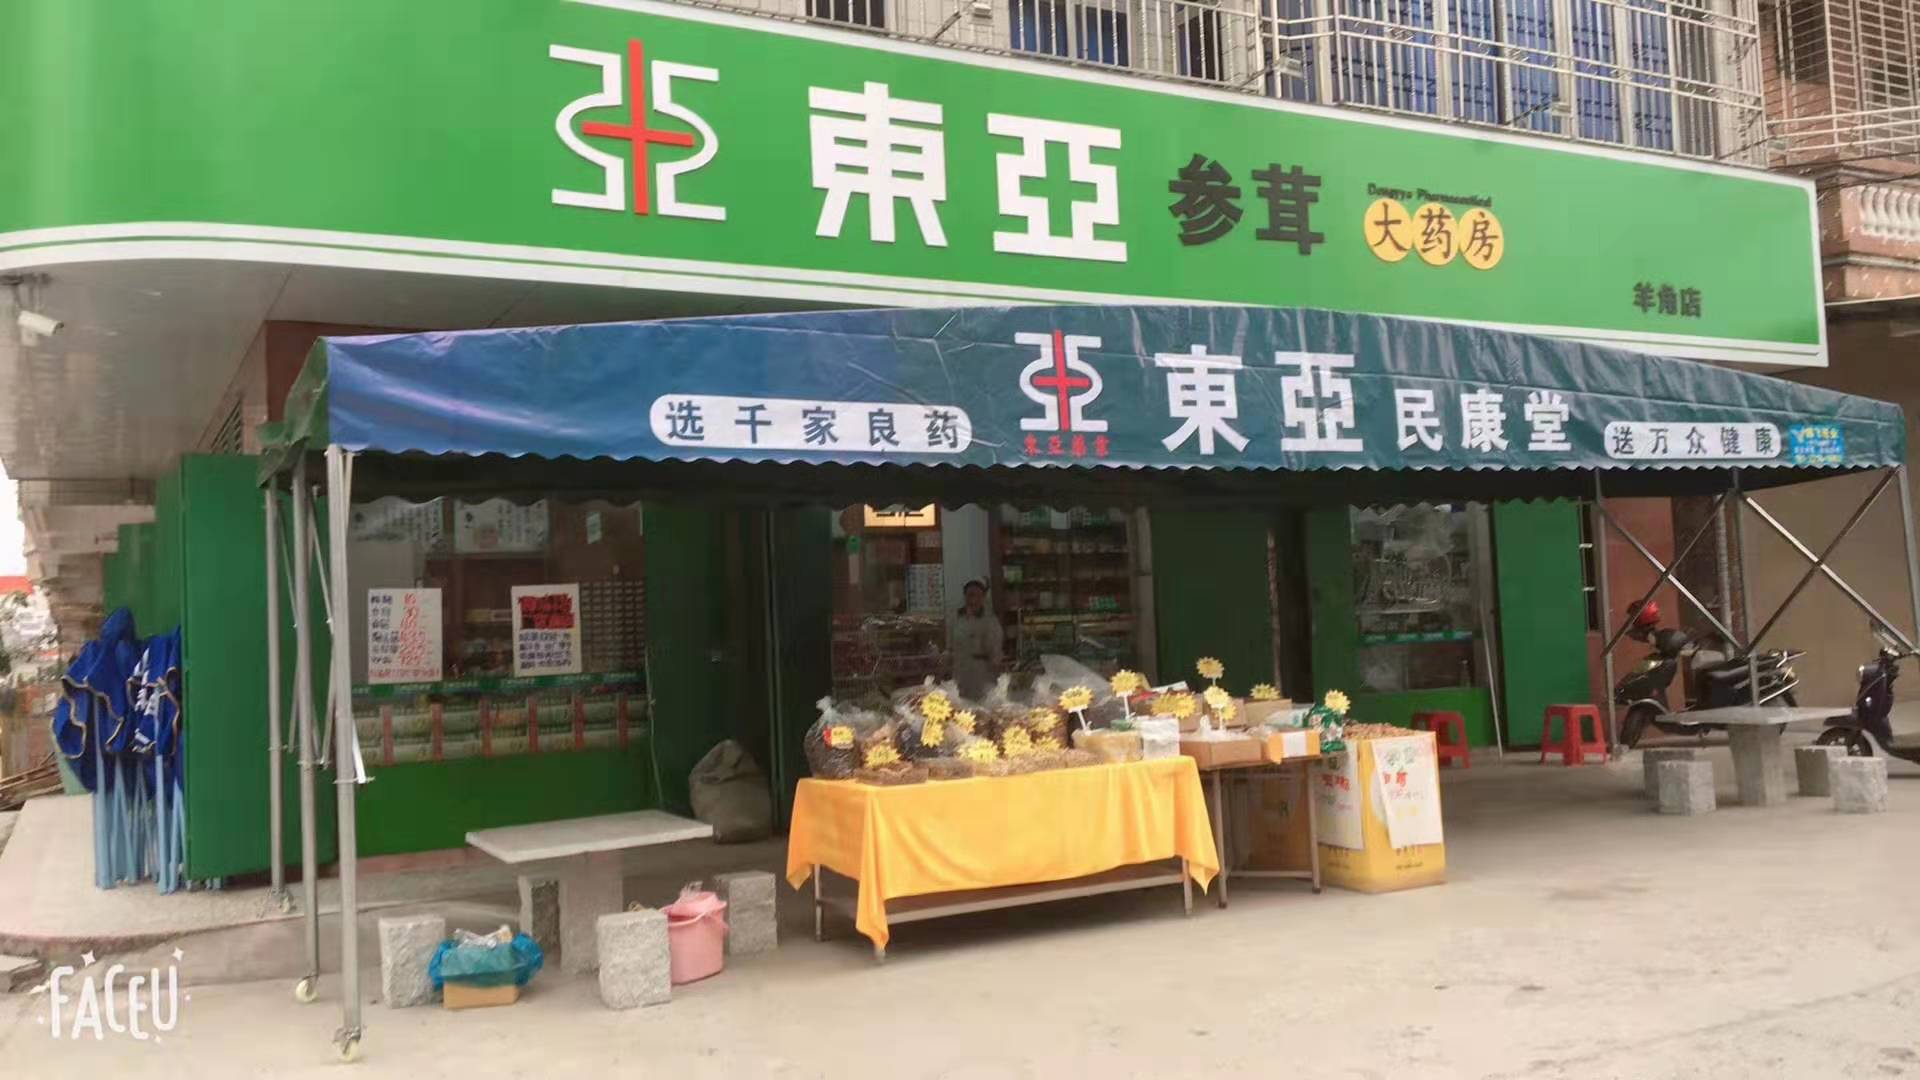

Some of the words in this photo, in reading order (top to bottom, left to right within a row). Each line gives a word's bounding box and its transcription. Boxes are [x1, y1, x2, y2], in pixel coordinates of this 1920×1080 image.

[808, 80, 1128, 262] 東亞
[1168, 153, 1325, 256] 参茸
[1373, 201, 1499, 262] 大药房
[1632, 281, 1702, 318] 羊角店
[664, 400, 960, 449] 选千家良药
[1612, 426, 1774, 455] 送万众健康
